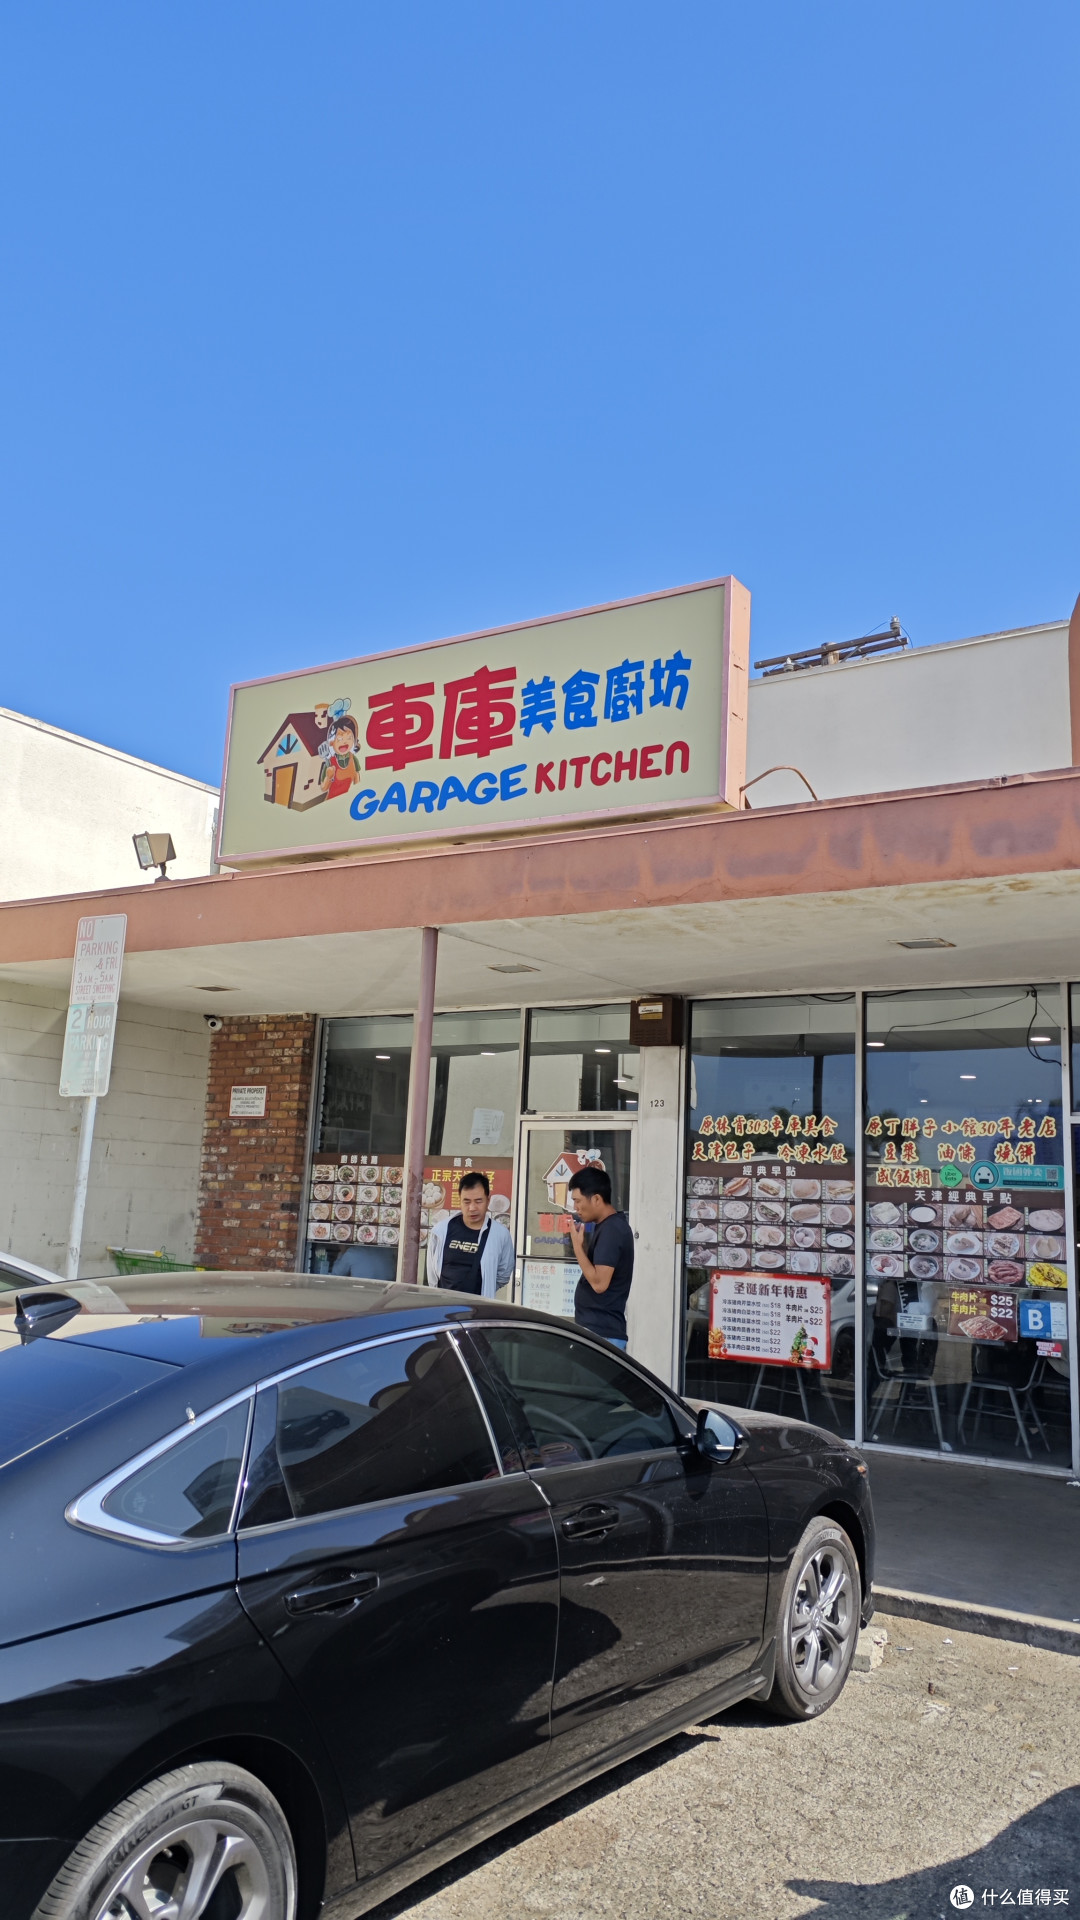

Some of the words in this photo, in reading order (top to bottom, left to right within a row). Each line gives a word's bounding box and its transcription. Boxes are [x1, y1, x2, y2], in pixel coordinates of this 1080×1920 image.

[350, 764, 528, 821] GARAGE
[80, 920, 93, 938] NO
[80, 941, 118, 956] PARKING
[75, 984, 92, 995] STREET
[93, 983, 116, 994] SWEEPING
[71, 1009, 82, 1029] 2
[87, 1015, 111, 1030] HOUR
[71, 1034, 109, 1051] PARKING
[650, 1100, 665, 1108] 123
[692, 1141, 755, 1162] 天津包子
[743, 1165, 797, 1177] 經典早點
[914, 1190, 1012, 1204] 天津經典早點
[734, 1281, 808, 1299] 圣诞新年特惠
[951, 1291, 978, 1302] 牛肉片
[990, 1294, 1013, 1306] $25
[786, 1303, 803, 1312] 牛肉片
[810, 1306, 823, 1314] $25
[951, 1303, 978, 1315] 羊肉片
[990, 1307, 1013, 1318] $22
[785, 1314, 803, 1323] 羊肉片
[809, 1317, 823, 1326] $22
[1028, 1309, 1043, 1330] B
